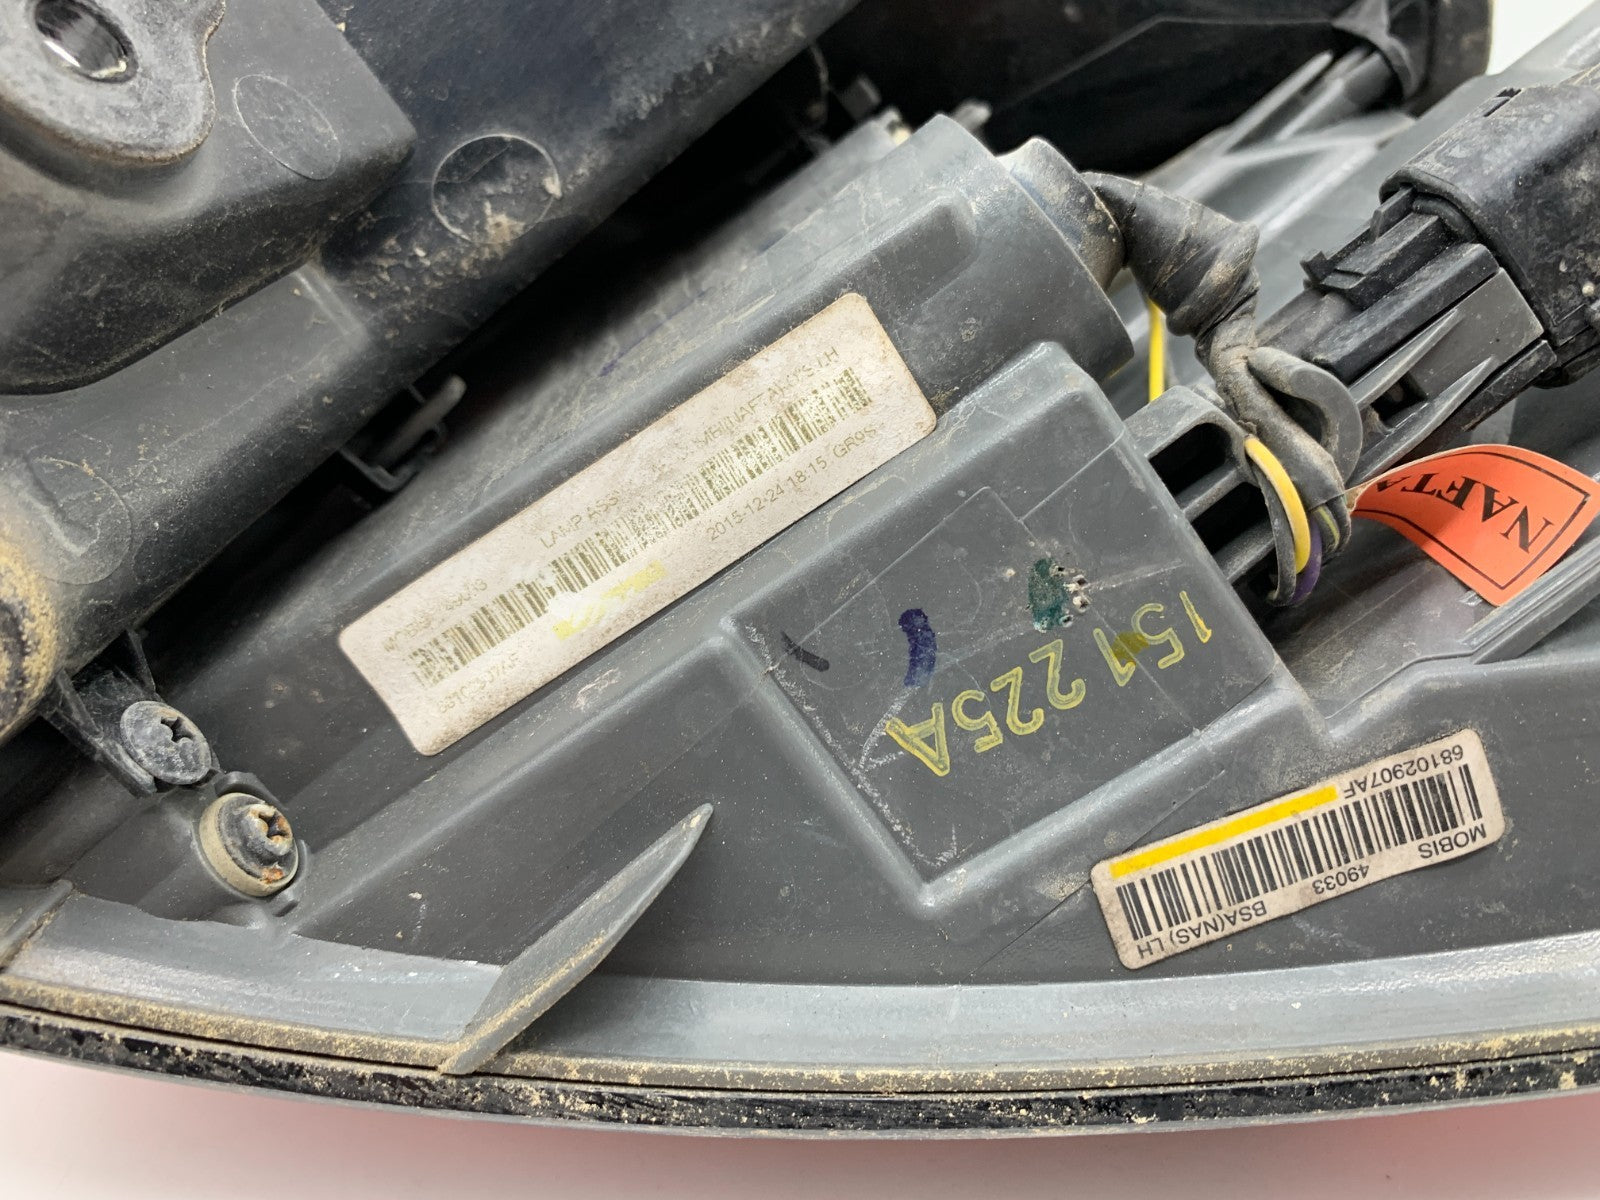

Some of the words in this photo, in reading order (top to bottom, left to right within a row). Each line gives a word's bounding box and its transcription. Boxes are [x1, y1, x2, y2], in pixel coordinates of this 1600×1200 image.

[707, 484, 784, 539] 2015-12-24
[788, 456, 826, 487] 18:15
[1376, 473, 1553, 553] NAFTA
[1340, 744, 1465, 797] 68102907AF
[1417, 824, 1487, 859] MOBIS
[1310, 863, 1371, 894] 49033
[1167, 899, 1266, 944] BSA(NAS)
[1136, 936, 1164, 958] LH
